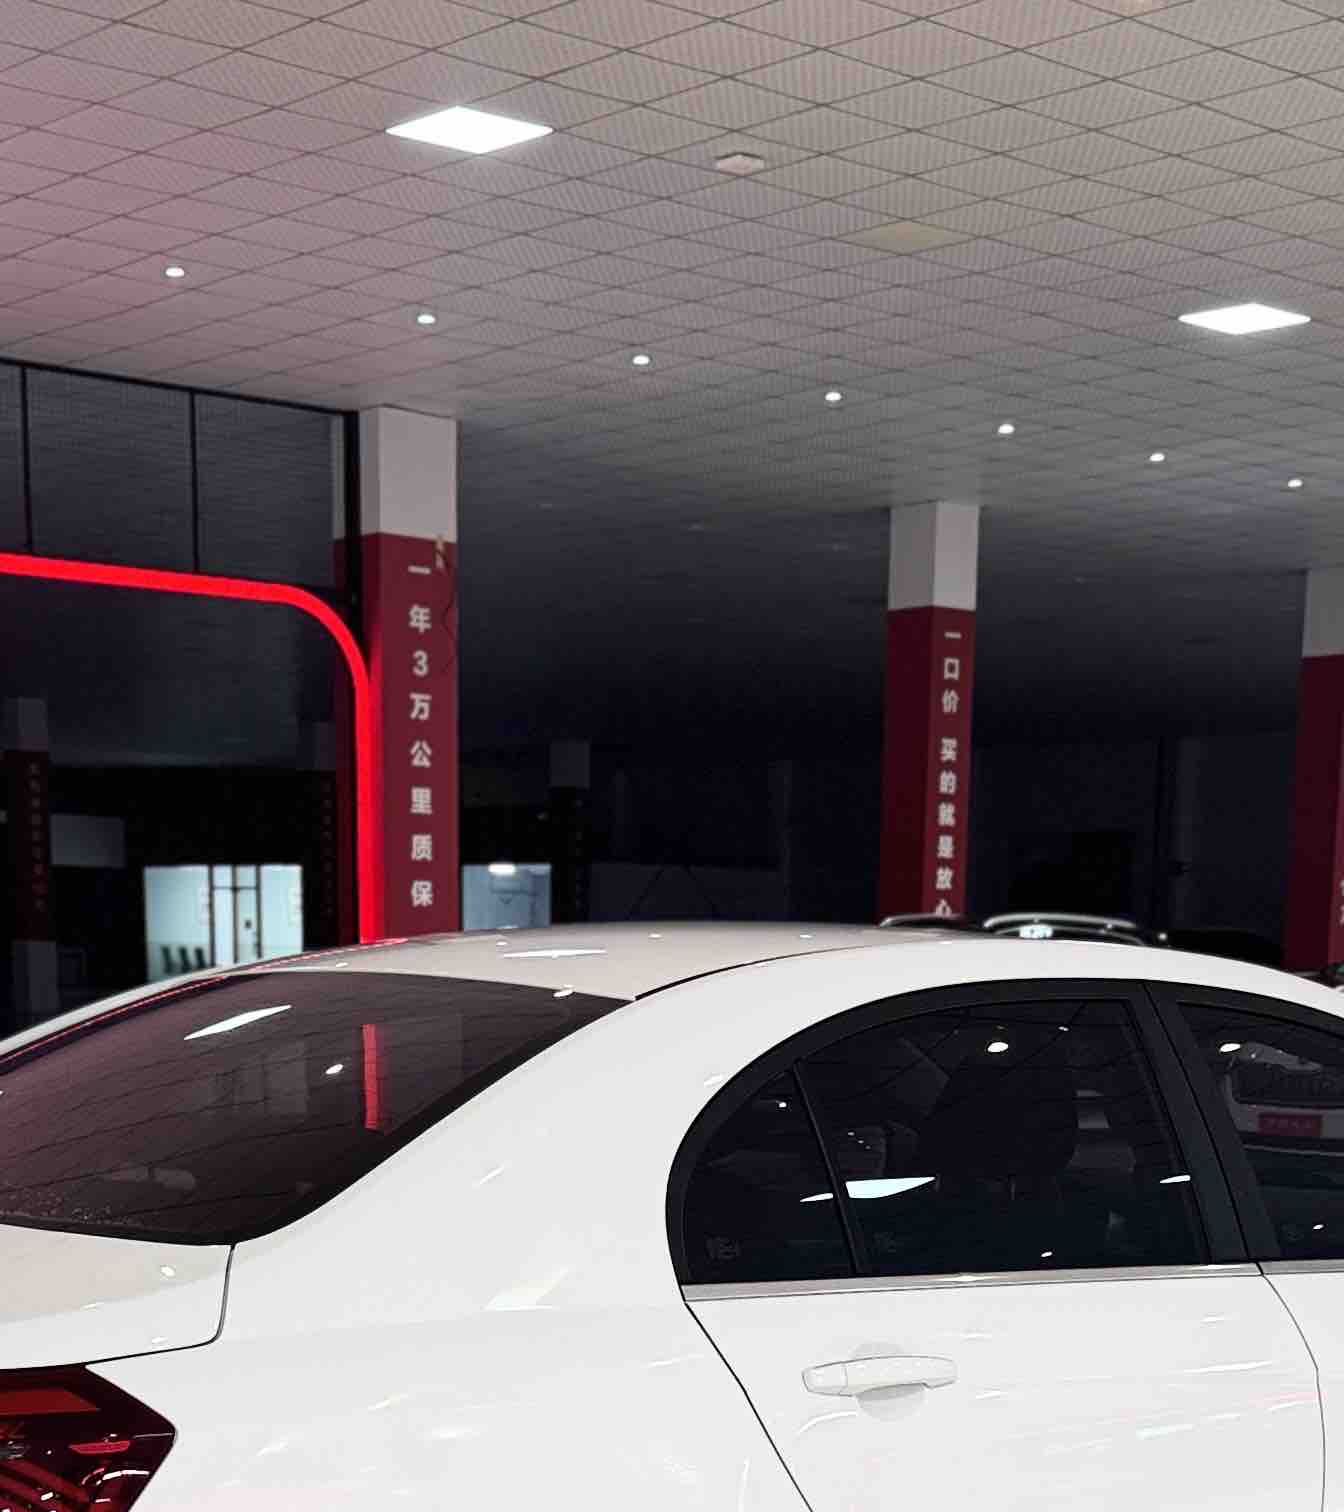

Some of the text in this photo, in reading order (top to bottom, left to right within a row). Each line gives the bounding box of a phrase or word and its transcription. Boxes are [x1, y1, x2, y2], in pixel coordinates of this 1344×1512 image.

[407, 565, 433, 907] 一年3万公里质保
[941, 631, 962, 713] 一口价
